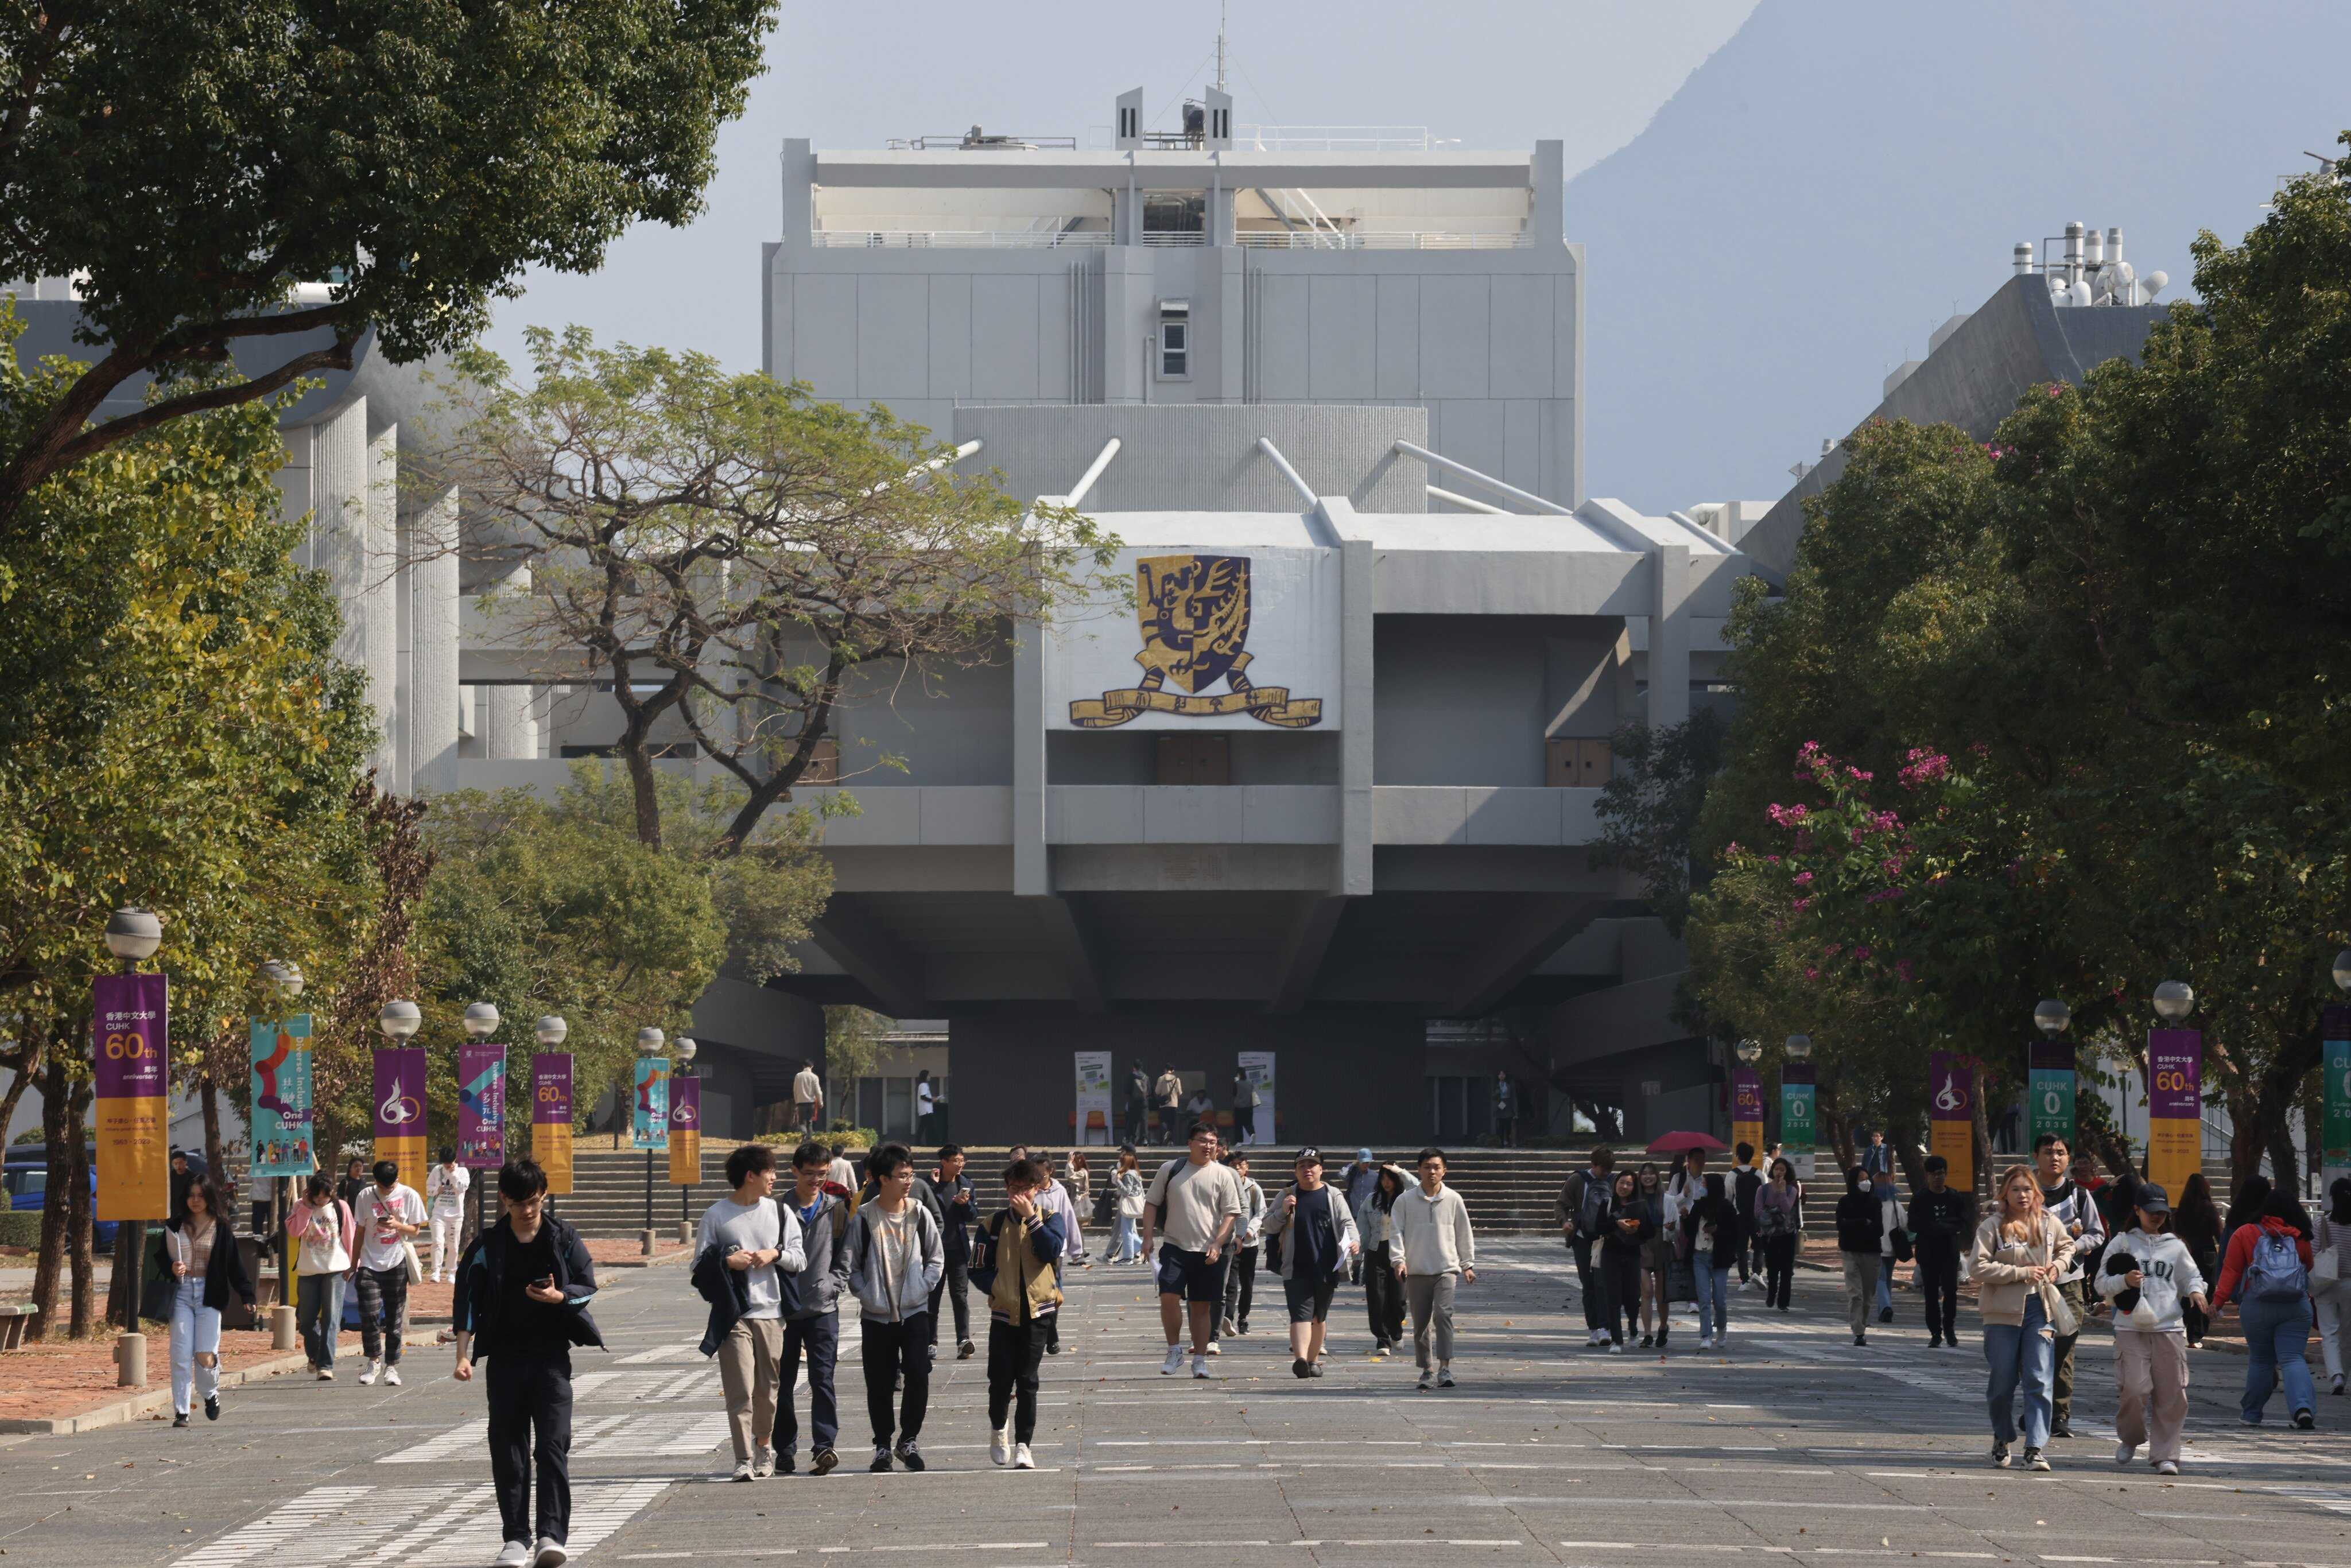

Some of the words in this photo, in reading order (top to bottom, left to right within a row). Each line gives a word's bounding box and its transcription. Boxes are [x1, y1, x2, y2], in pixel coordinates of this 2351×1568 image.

[106, 1011, 156, 1020] 香港中文大學
[106, 1033, 157, 1059] 60th
[2037, 1081, 2067, 1090] CUHK
[2156, 1072, 2194, 1091] 60th
[538, 1086, 567, 1102] 60th
[1793, 1100, 1805, 1117] 0
[2044, 1092, 2061, 1115] 0
[283, 1111, 303, 1119] One
[276, 1121, 303, 1130] CUHK
